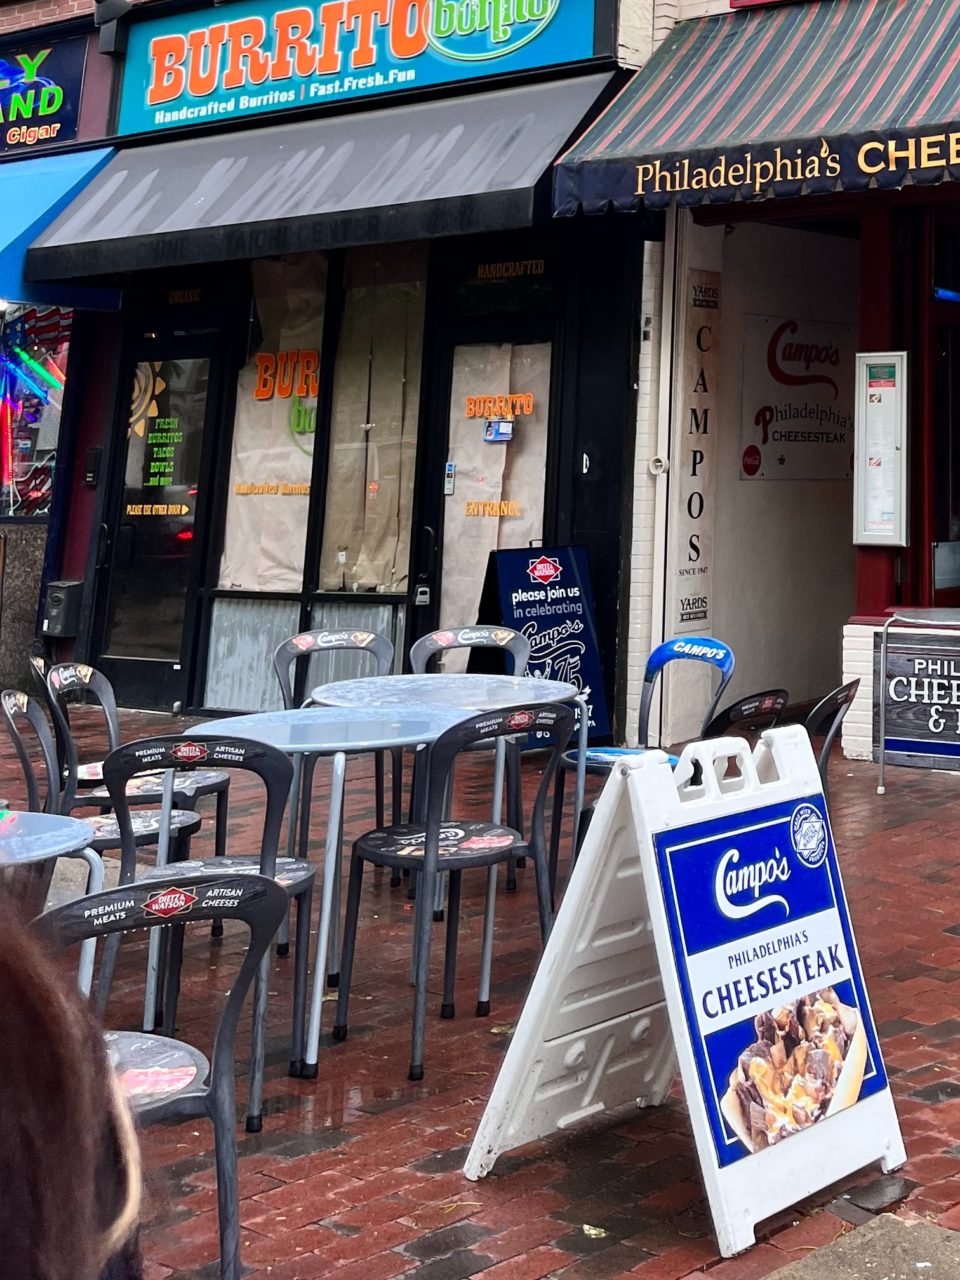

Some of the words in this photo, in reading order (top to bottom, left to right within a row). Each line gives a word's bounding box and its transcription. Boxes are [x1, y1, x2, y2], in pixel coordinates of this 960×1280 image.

[154, 98, 235, 125] Handcrafted
[238, 88, 296, 112] Burritos
[309, 67, 416, 98] Fast.Fresh.Fun
[7, 123, 61, 144] Cigar
[633, 137, 841, 196] Philadelphia's
[477, 259, 545, 279] HANDCRAFTED
[693, 285, 719, 299] YARDS
[767, 320, 840, 392] Campo's
[465, 393, 534, 417] BURRITO
[155, 418, 179, 429] FRESH
[147, 432, 183, 444] BURRITOS
[772, 430, 846, 444] CHEESESTEAK
[153, 447, 175, 458] TACOS
[149, 462, 174, 473] BOWLS
[126, 505, 143, 515] PLEASE
[143, 505, 152, 515] USE
[152, 504, 168, 515] OTHER
[167, 504, 181, 515] DOOR
[464, 500, 521, 517] ENTRANCE
[679, 567, 696, 577] SINCE
[512, 588, 546, 605] please
[547, 586, 567, 602] join
[567, 586, 580, 597] us
[513, 606, 523, 618] in
[525, 601, 583, 617] celebrating
[681, 597, 708, 611] YARDS
[673, 641, 727, 660] CAMPO'S
[475, 718, 503, 729] PREMIUM
[928, 706, 946, 733] &
[480, 725, 498, 734] MEATS
[135, 747, 166, 758] PREMIUM
[177, 750, 201, 758] WATSON
[215, 746, 246, 755] ARTISAN
[142, 754, 163, 764] MEATS
[213, 753, 244, 763] CHEESES
[715, 847, 791, 919] Campo's
[206, 888, 244, 898] ARTISAN
[84, 900, 135, 919] PREMIUM
[151, 898, 187, 911] WATSON
[202, 898, 240, 908] CHEESES
[93, 911, 127, 926] MEATS
[728, 930, 809, 970] PHILADELPHIA'S
[702, 943, 845, 1020] CHEESESTEAK
